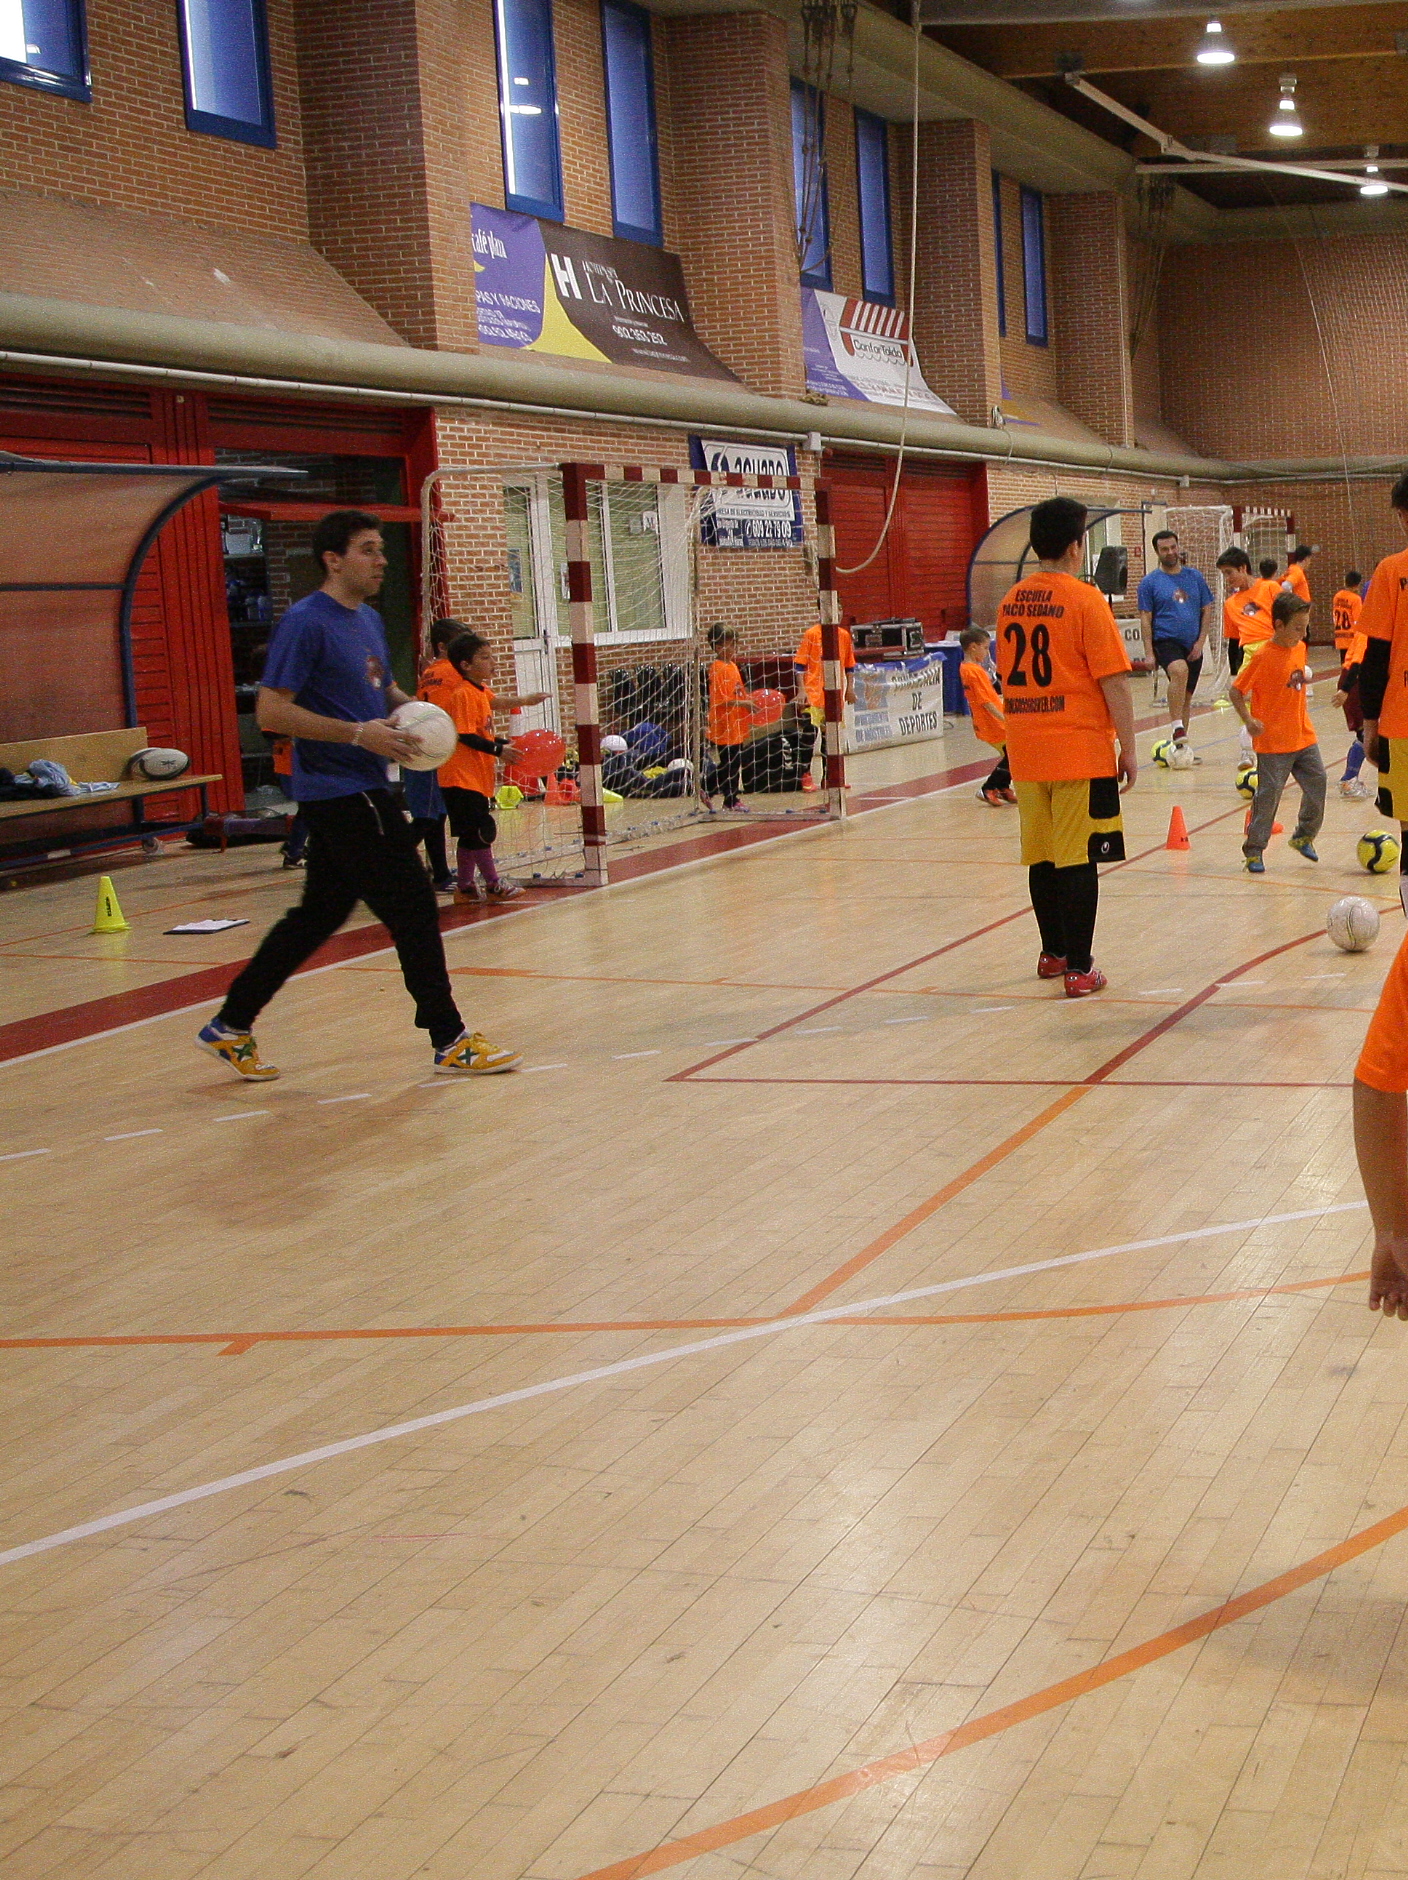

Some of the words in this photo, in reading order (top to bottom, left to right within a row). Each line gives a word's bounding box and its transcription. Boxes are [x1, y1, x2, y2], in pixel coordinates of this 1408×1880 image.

[1015, 589, 1054, 602] ESCUELA
[1003, 604, 1025, 617] PACO
[1026, 604, 1065, 619] SEDANO
[1335, 609, 1352, 630] 28
[1004, 622, 1053, 688] 28
[912, 691, 923, 711] DE
[898, 710, 939, 736] DEPORTES
